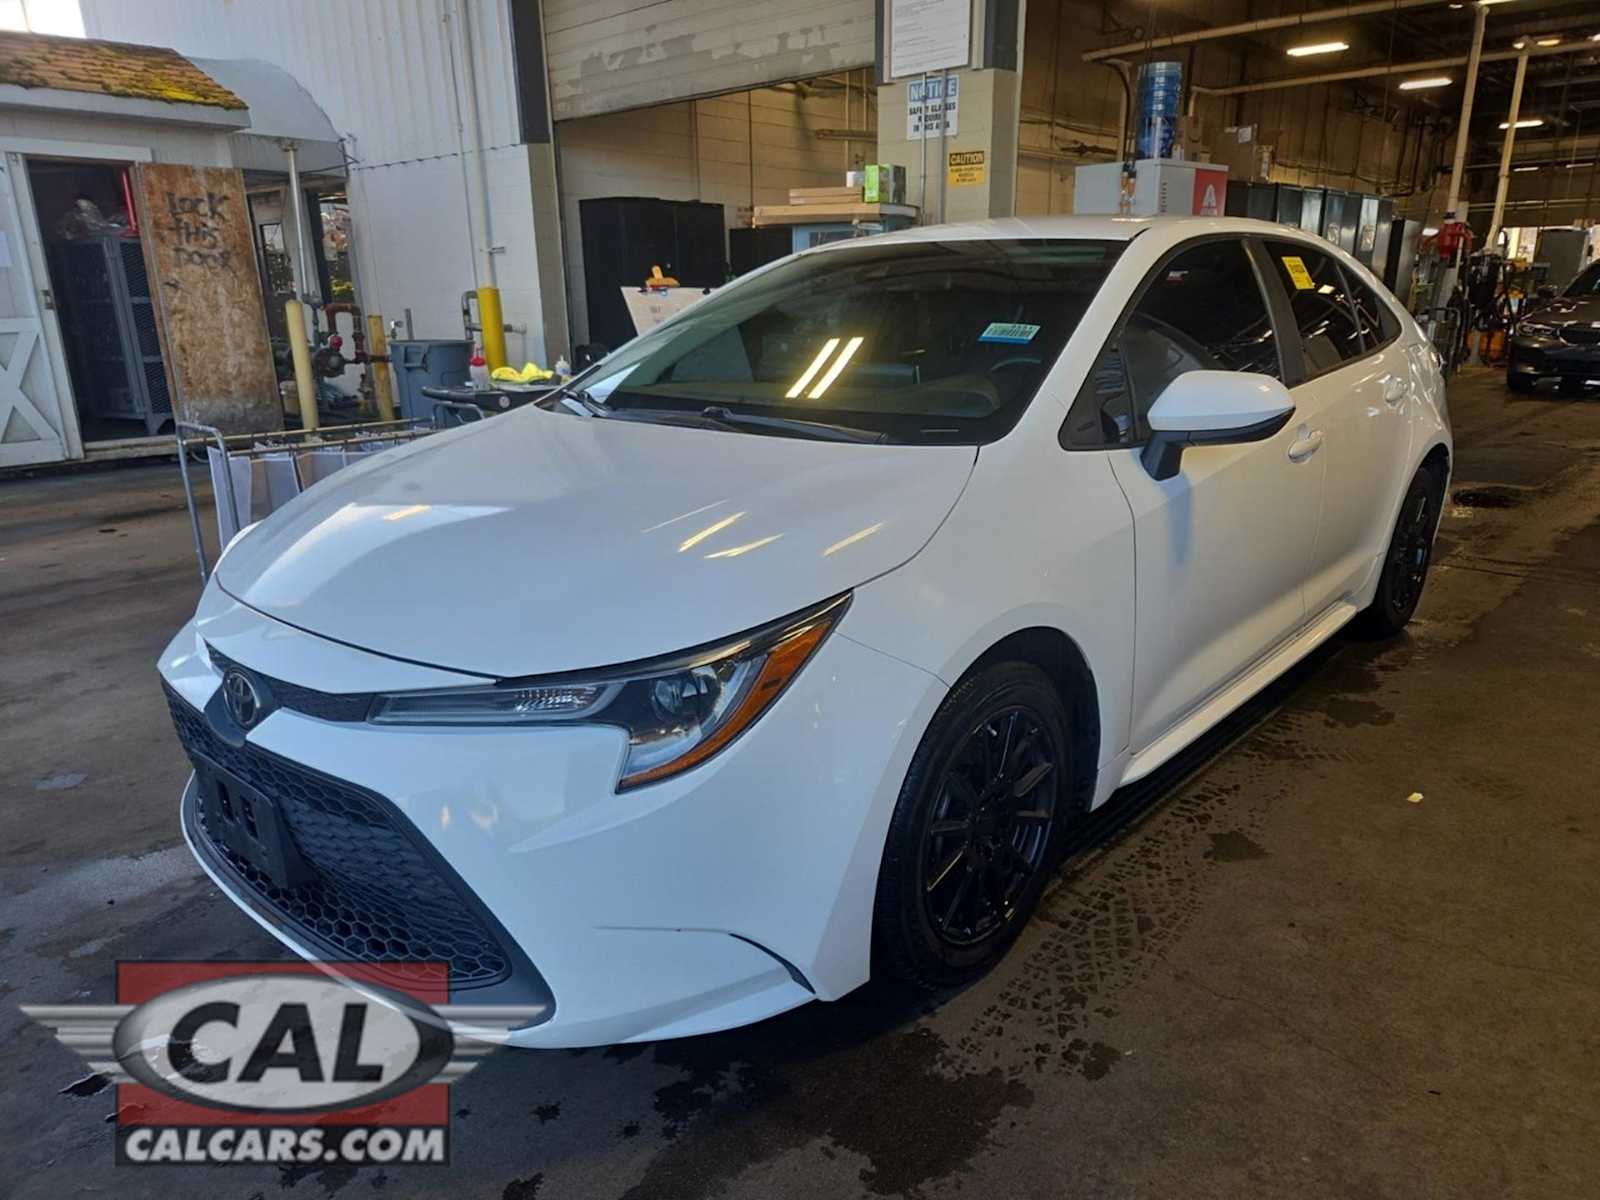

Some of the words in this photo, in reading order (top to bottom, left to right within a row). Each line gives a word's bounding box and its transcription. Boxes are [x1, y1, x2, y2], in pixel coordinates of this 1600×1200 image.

[909, 105, 929, 115] SAFEY
[931, 102, 956, 112] GLASES
[918, 113, 946, 122] RQUIR
[951, 153, 983, 164] CAUTION
